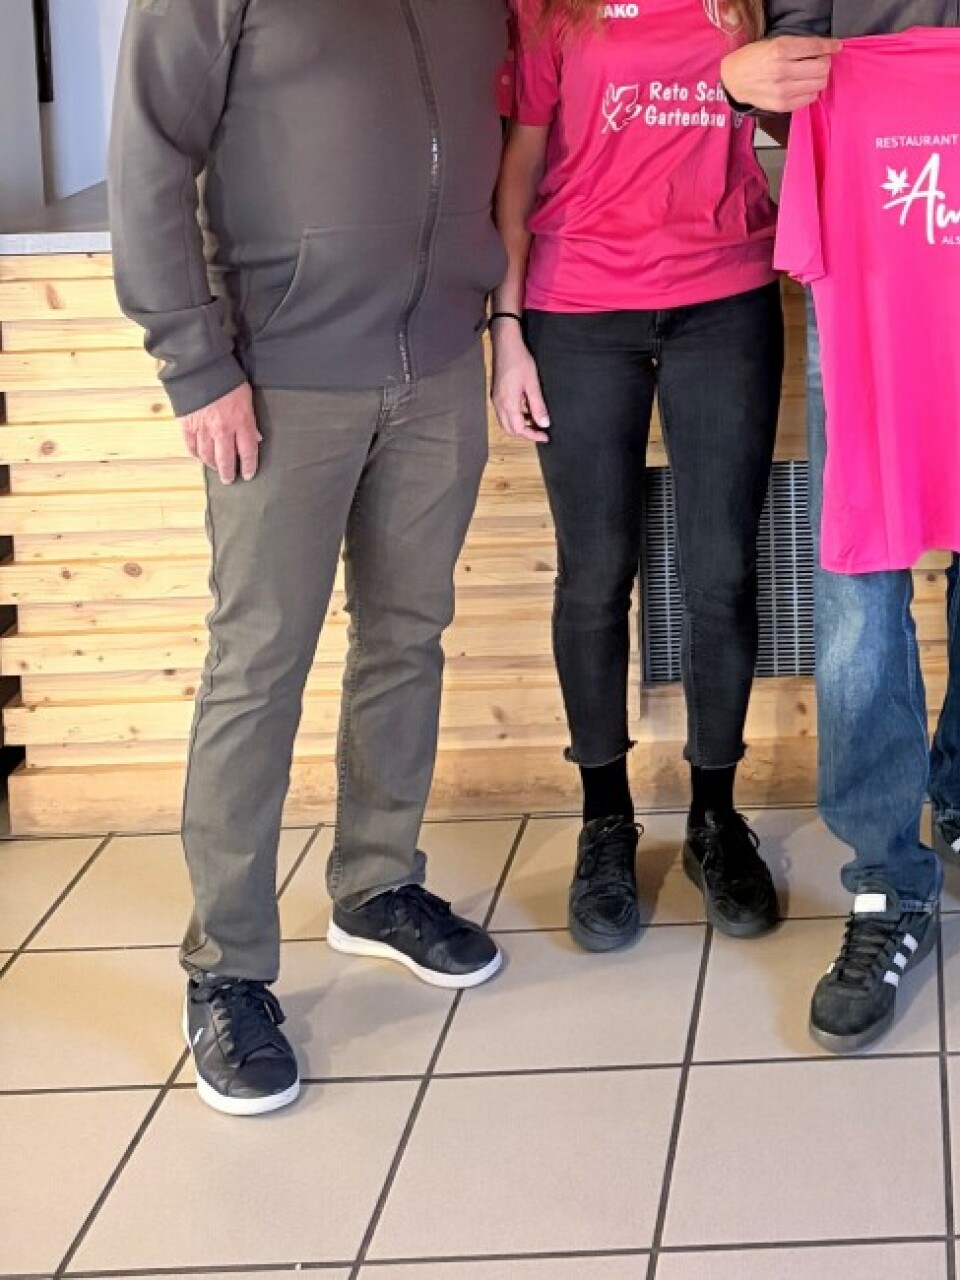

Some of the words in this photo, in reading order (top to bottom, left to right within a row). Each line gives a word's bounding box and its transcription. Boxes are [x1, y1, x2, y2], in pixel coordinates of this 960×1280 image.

[599, 3, 639, 18] AKO
[649, 80, 689, 102] Reto
[695, 80, 728, 104] Sch
[875, 133, 960, 149] RESTAURANT
